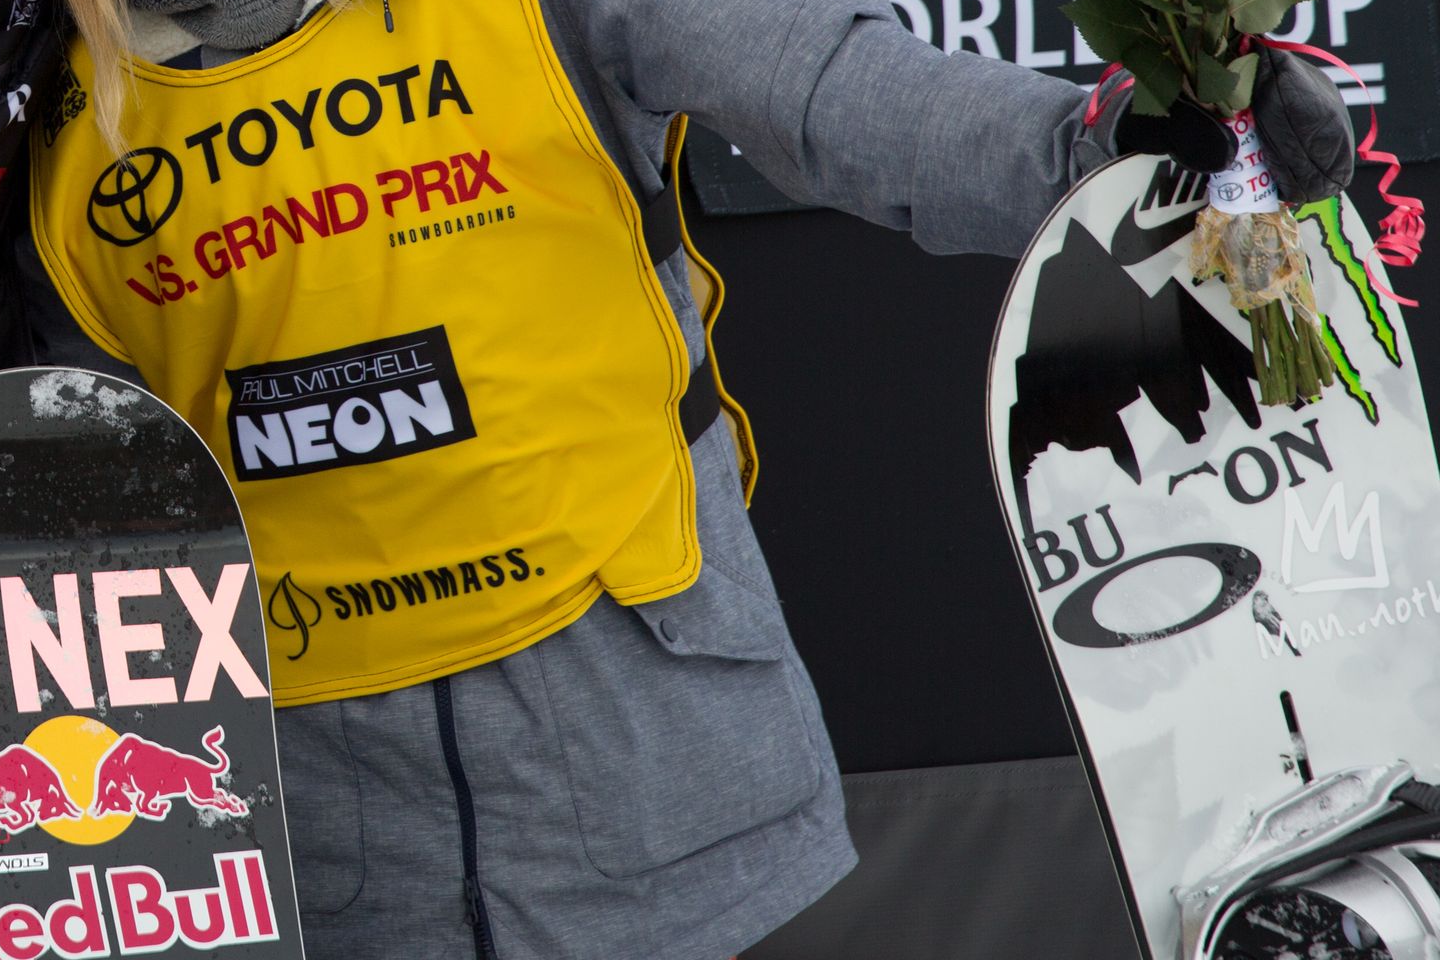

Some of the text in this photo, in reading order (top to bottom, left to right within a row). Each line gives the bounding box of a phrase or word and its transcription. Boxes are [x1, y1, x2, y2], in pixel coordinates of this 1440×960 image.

[184, 59, 474, 185] TOYOTA
[193, 182, 369, 281] GRAND
[388, 204, 517, 249] SNOWBOARDING
[239, 348, 434, 402] PAUL MITCHELL
[235, 379, 455, 471] NEON
[106, 849, 281, 956] Bull
